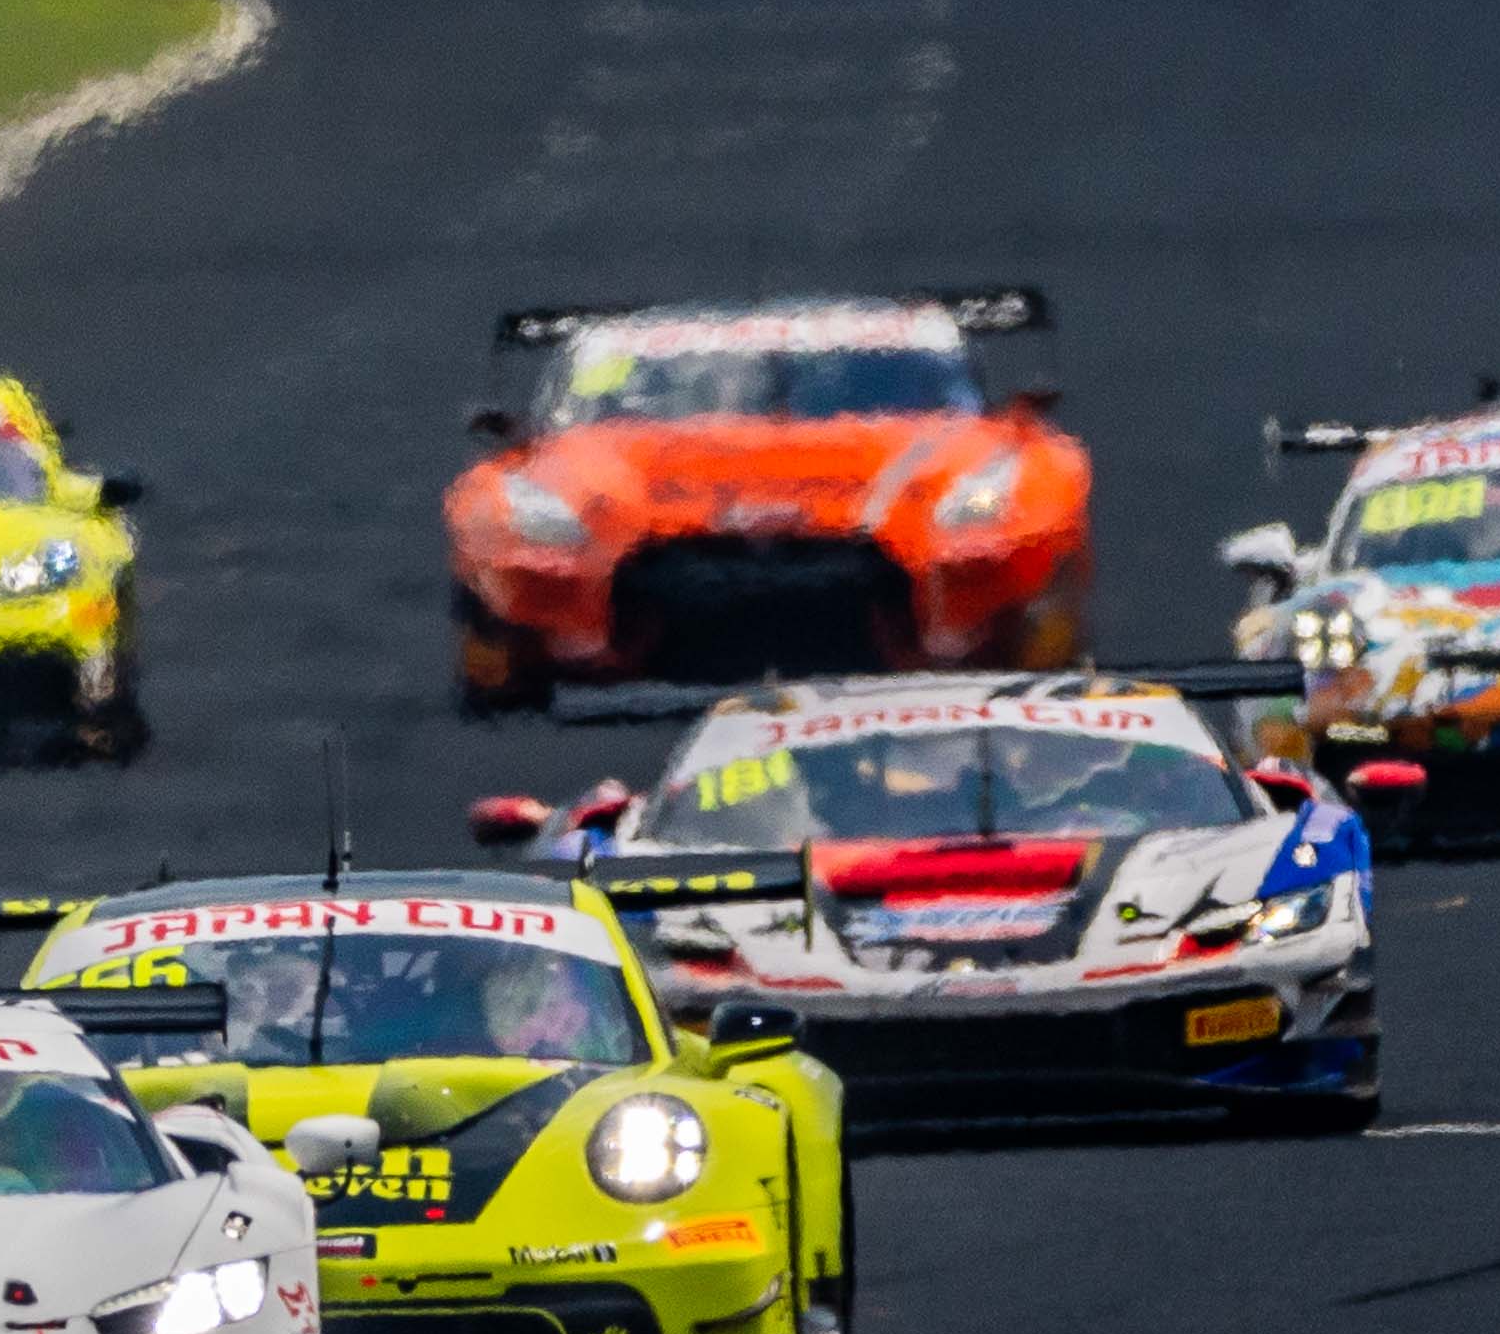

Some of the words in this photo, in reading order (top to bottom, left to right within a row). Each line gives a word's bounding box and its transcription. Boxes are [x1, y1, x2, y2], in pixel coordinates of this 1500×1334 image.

[758, 703, 991, 749] JAPAN
[1020, 703, 1155, 730] CUP
[102, 899, 374, 955] JAPAN
[404, 900, 557, 938] CUP
